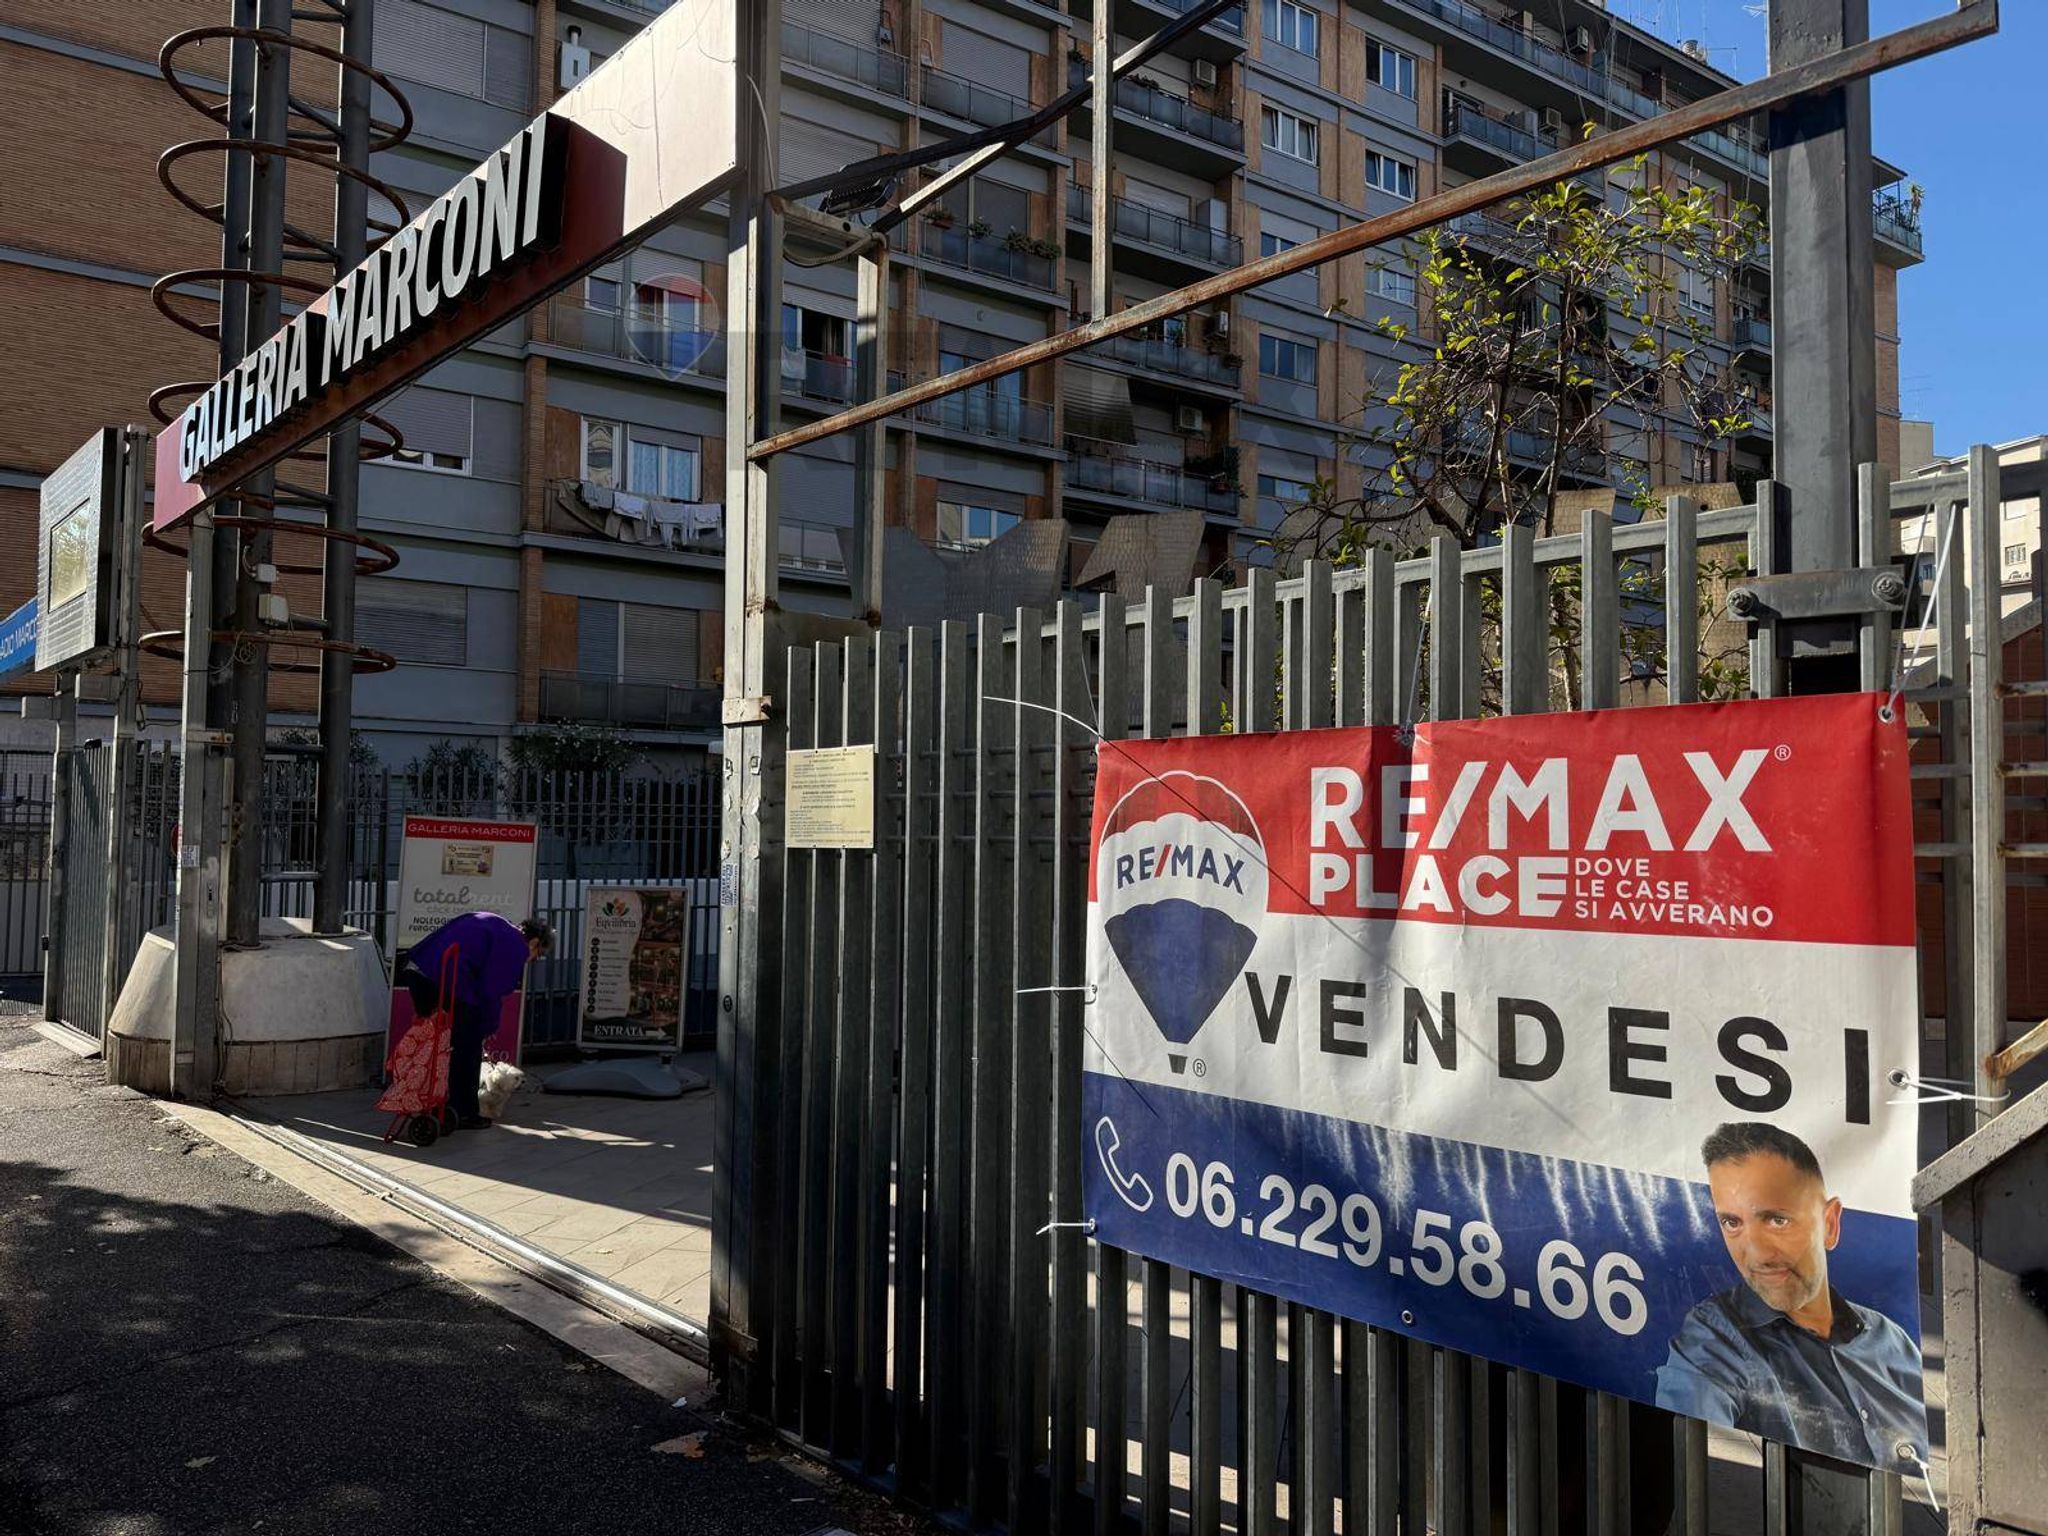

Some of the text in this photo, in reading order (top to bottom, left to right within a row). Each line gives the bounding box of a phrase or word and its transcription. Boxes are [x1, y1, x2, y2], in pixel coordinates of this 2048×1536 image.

[180, 113, 547, 483] GALLERIA MARCONI
[1311, 748, 1772, 852] RE/MAX
[407, 822, 530, 838] GALLERIA MARCONI
[1116, 843, 1245, 896] RE/MAX
[1310, 853, 1567, 917] PLACE
[1575, 857, 1650, 877] DOVE
[1575, 878, 1689, 901] LE CASE
[1575, 900, 1774, 928] SI AVVERANO
[593, 1024, 645, 1036] ENTRATA
[1244, 971, 1871, 1125] VENDESI
[1165, 1151, 1648, 1336] 06.229.58.66
